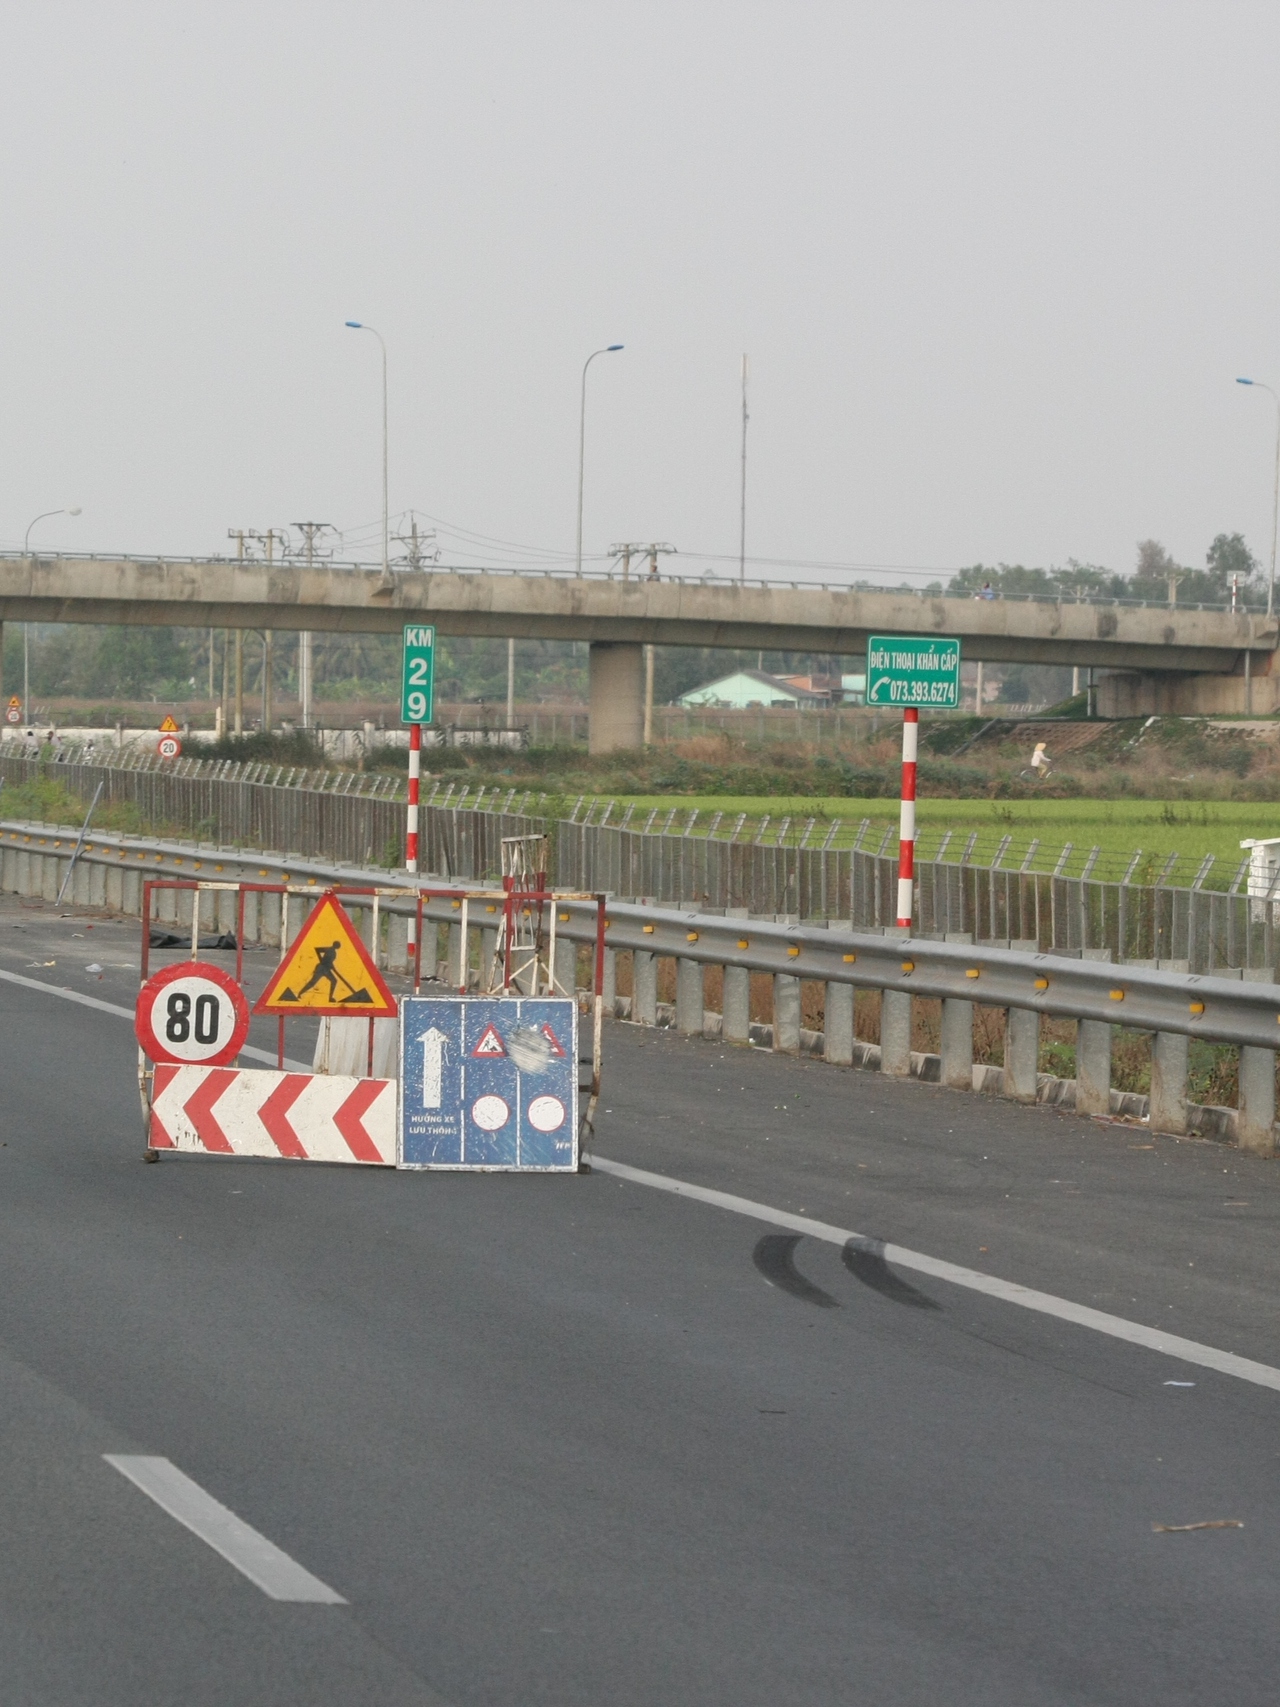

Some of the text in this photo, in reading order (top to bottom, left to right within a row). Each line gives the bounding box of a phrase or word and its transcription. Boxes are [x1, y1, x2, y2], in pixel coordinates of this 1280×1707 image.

[406, 628, 432, 647] KM
[870, 644, 957, 673] ĐIỆN THOẠI KHẨN CẤP
[889, 680, 955, 702] 073.393.6274
[163, 742, 175, 753] 20
[165, 991, 219, 1044] 80
[444, 1114, 455, 1123] XE
